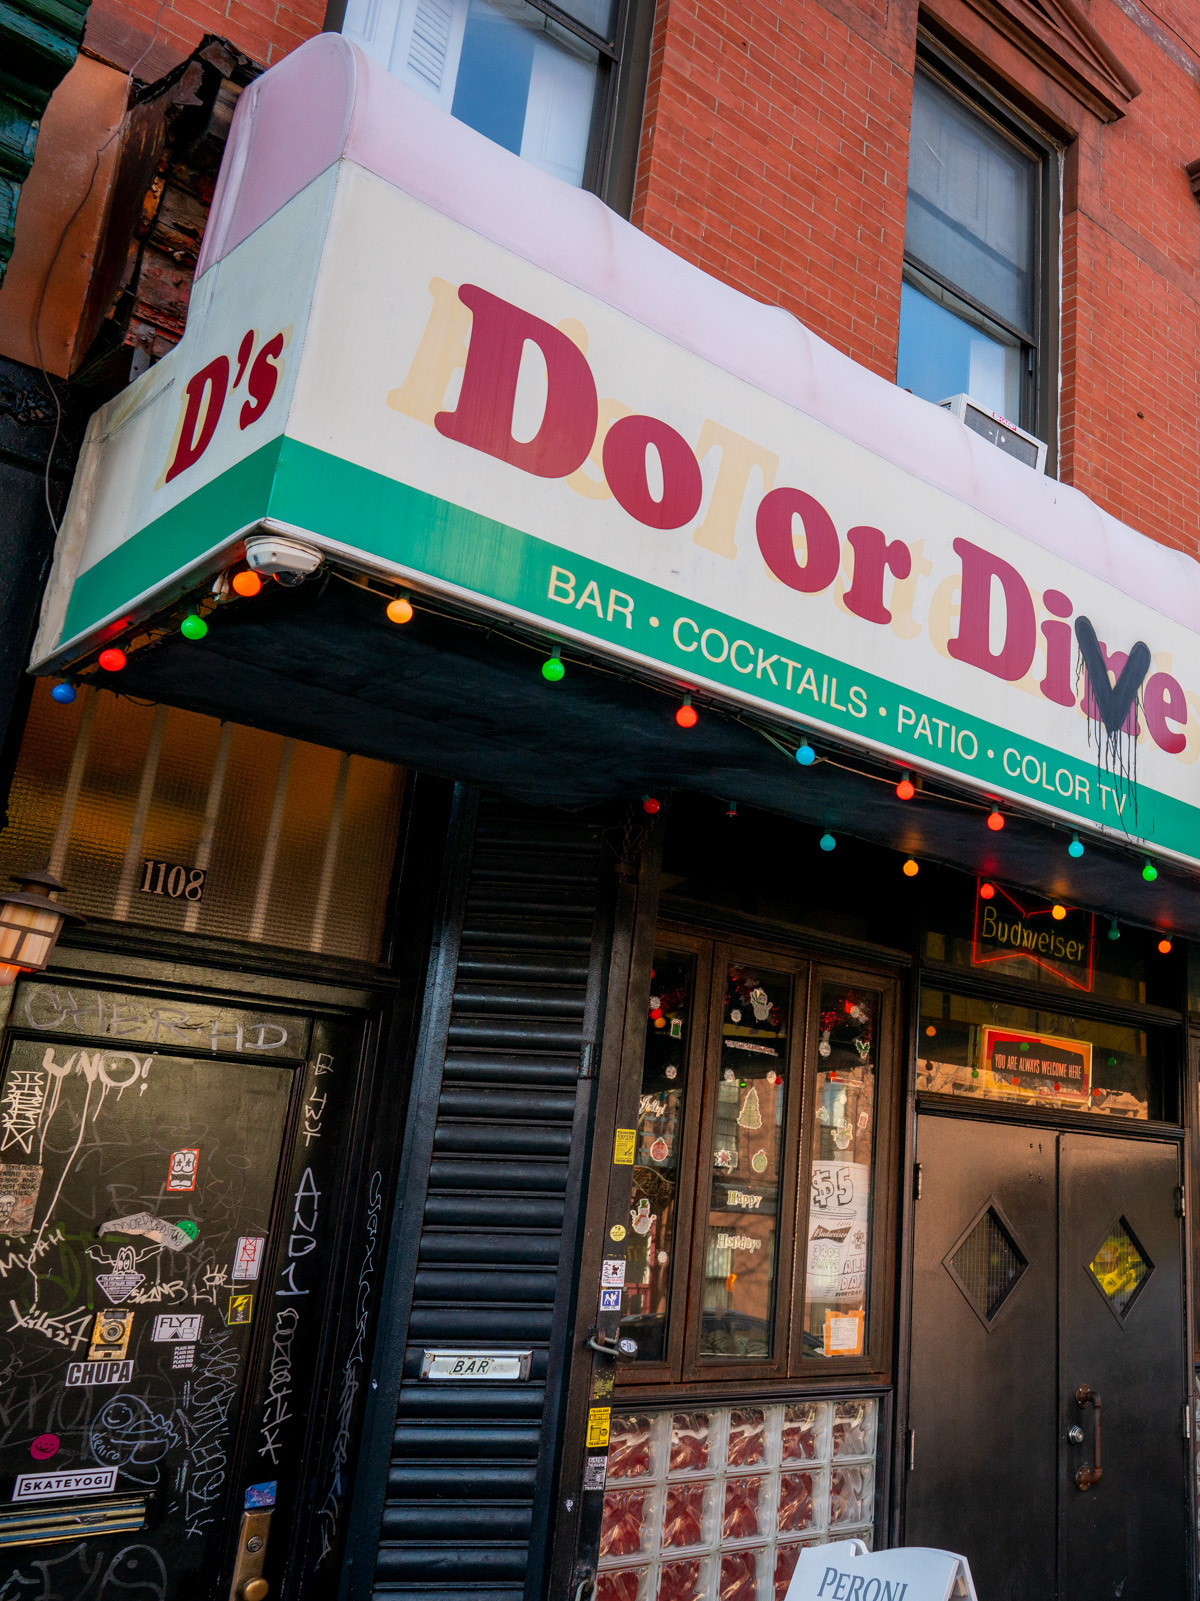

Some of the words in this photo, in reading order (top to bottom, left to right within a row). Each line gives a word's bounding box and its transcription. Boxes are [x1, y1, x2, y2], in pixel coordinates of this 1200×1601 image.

[166, 329, 283, 485] D's
[434, 283, 702, 530] Do
[755, 487, 911, 625] or
[548, 565, 635, 630] BAR
[672, 617, 868, 719] COCKTAILS
[897, 704, 979, 760] PATIO
[1002, 748, 1091, 803] COLOR
[1096, 783, 1127, 816] TV
[140, 861, 204, 901] 1108
[982, 906, 1085, 961] Budweiser
[995, 1053, 1006, 1069] YOU
[1007, 1056, 1018, 1071] ARE
[1019, 1057, 1040, 1074] ALWAYS
[1041, 1060, 1067, 1077] WELCOME
[1068, 1065, 1082, 1079] HERE
[811, 1166, 854, 1209] $5
[727, 1189, 762, 1208] Happy
[717, 1233, 762, 1254] Holidays
[813, 1227, 848, 1239] Budweiser
[842, 1259, 866, 1275] ALL
[160, 1317, 199, 1328] FLYT
[158, 1328, 196, 1340] LAB
[69, 1364, 131, 1385] CHUPA
[453, 1360, 489, 1373] BAR
[23, 1476, 109, 1491] SKATEYOGI
[817, 1566, 909, 1601] PERONI
